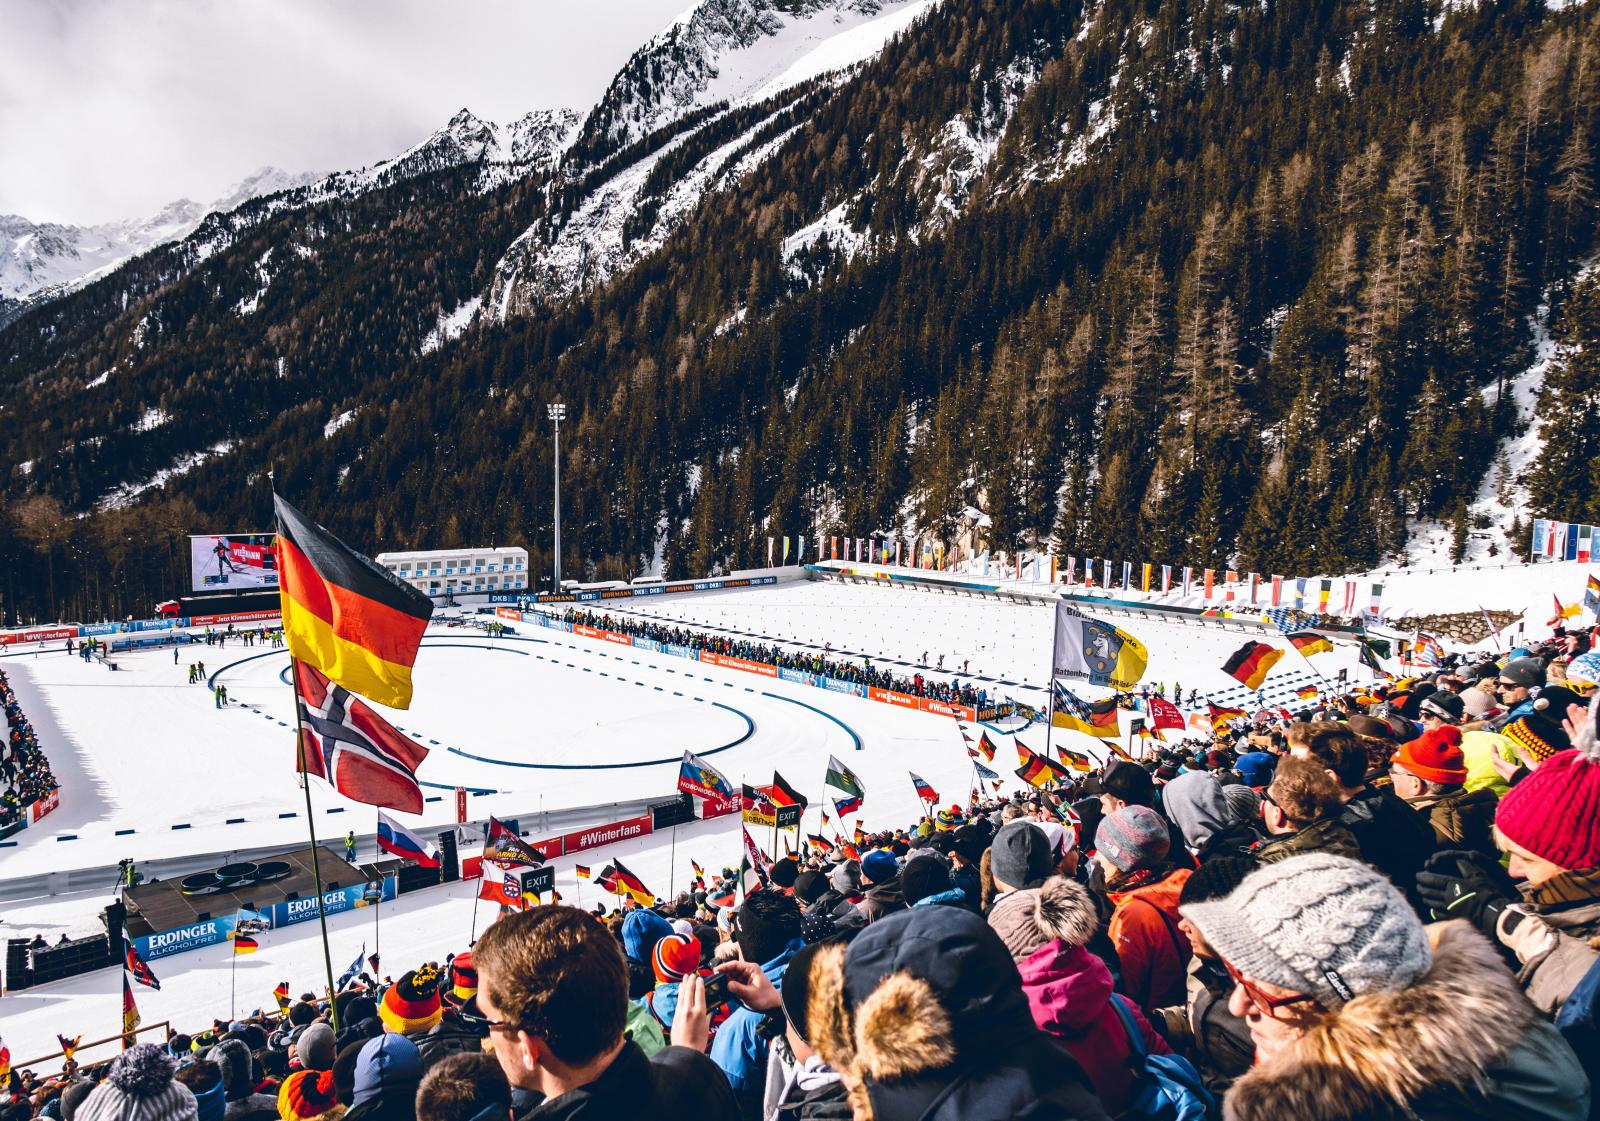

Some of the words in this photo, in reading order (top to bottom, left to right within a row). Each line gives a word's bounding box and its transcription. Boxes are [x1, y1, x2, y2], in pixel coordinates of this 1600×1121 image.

[780, 811, 796, 821] EXIT
[580, 824, 641, 847] #Winterfans
[526, 875, 548, 888] EXIT
[148, 922, 217, 949] ERDINGER
[149, 935, 217, 957] ALKOHOLFREI
